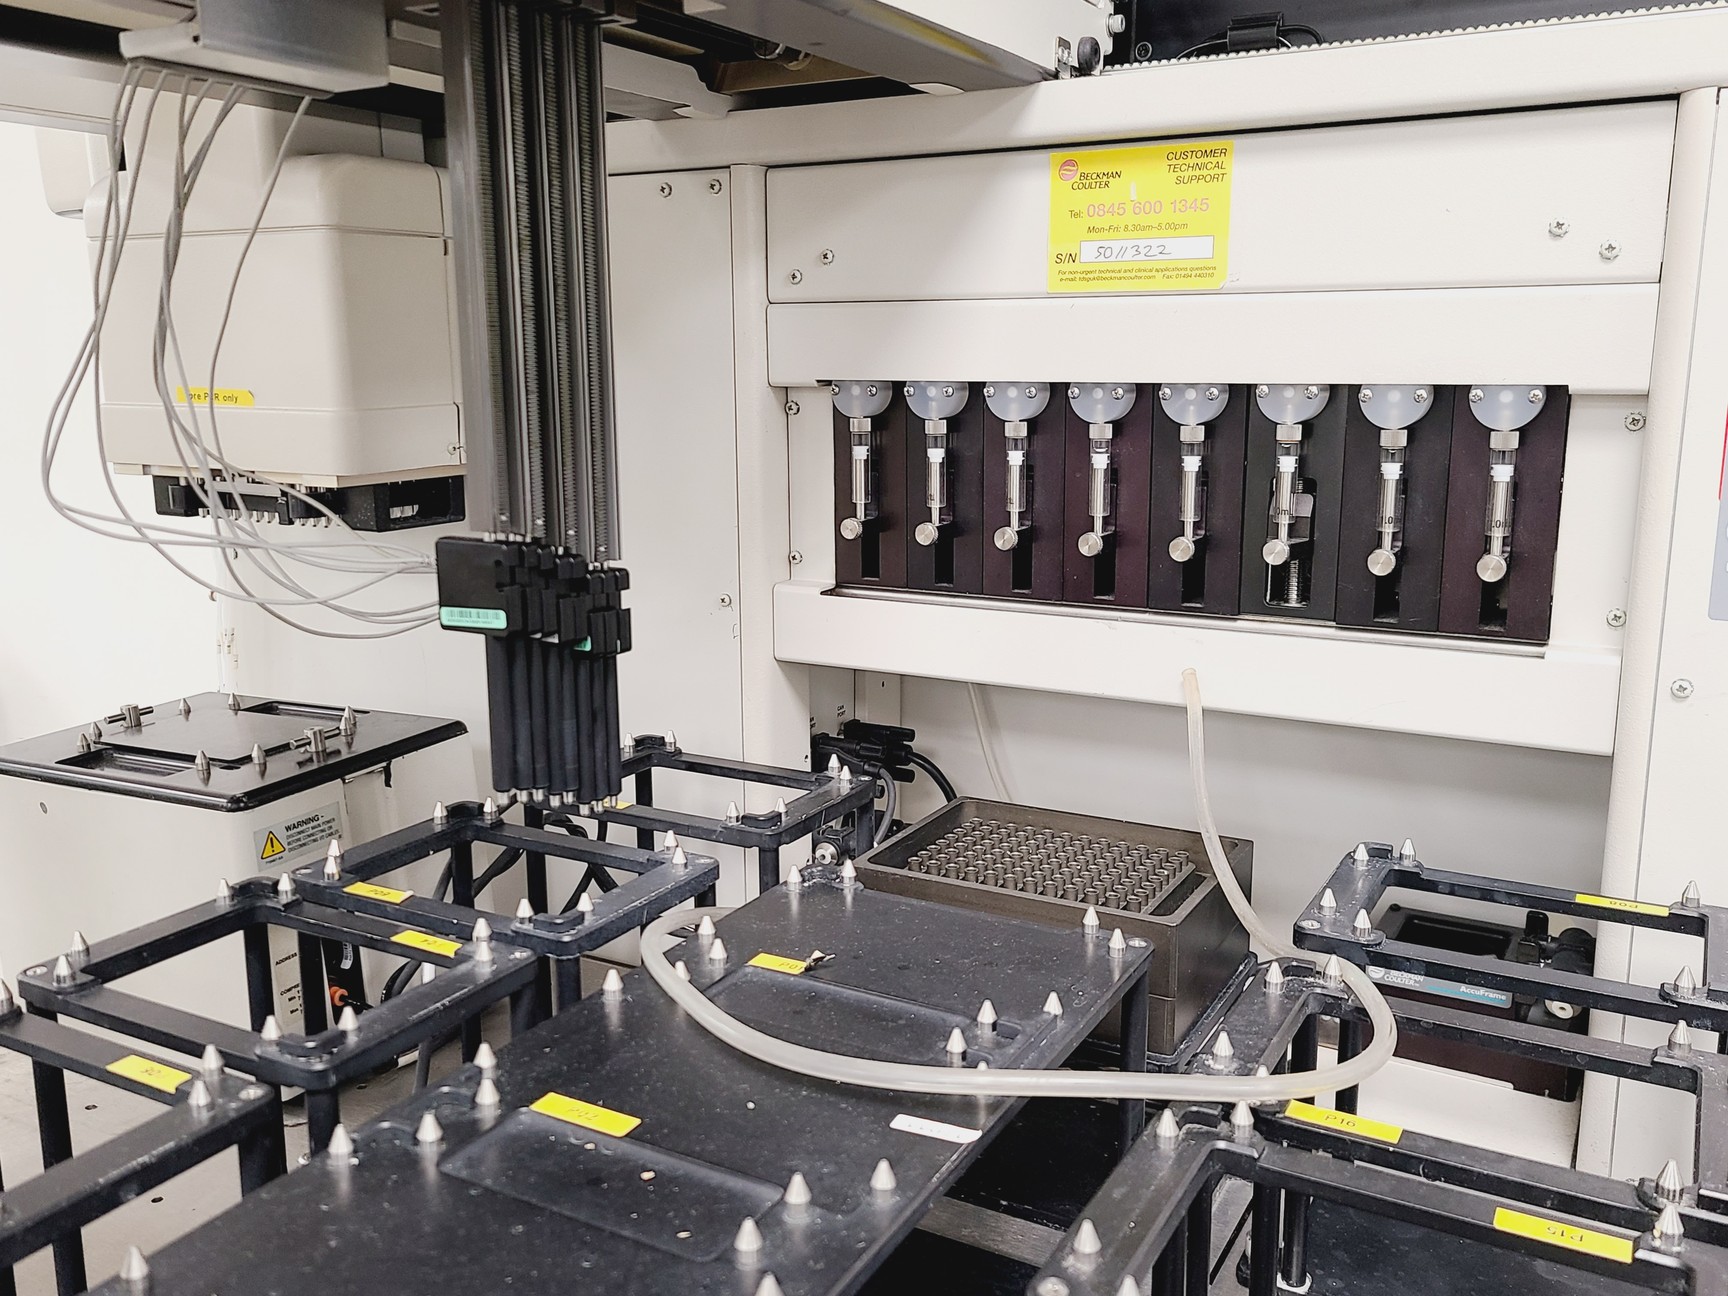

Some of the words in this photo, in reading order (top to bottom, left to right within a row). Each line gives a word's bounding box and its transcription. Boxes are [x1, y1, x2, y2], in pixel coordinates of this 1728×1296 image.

[1166, 148, 1227, 161] CUSTOMER
[1167, 161, 1226, 173] TECHNICAL
[1079, 171, 1122, 181] BECKMAN
[1175, 173, 1227, 185] SUPPORT
[1071, 181, 1110, 190] COULTER
[1069, 209, 1083, 219] Tel:
[1087, 202, 1126, 218] 0845
[1132, 200, 1163, 215] 600
[1170, 198, 1210, 213] 1345
[1087, 224, 1122, 234] Mon-Fri:
[1055, 253, 1077, 264] S/N
[1155, 266, 1188, 274] applications
[1189, 265, 1217, 273] questions
[204, 392, 220, 401] PR
[222, 394, 239, 404] only
[285, 814, 320, 833] WARNING
[275, 952, 298, 966] ADDRESS
[280, 983, 300, 996] COMPRE
[1460, 985, 1507, 1001] AccuFrame
[1325, 1113, 1357, 1127] P16
[1547, 1225, 1584, 1242] P15
